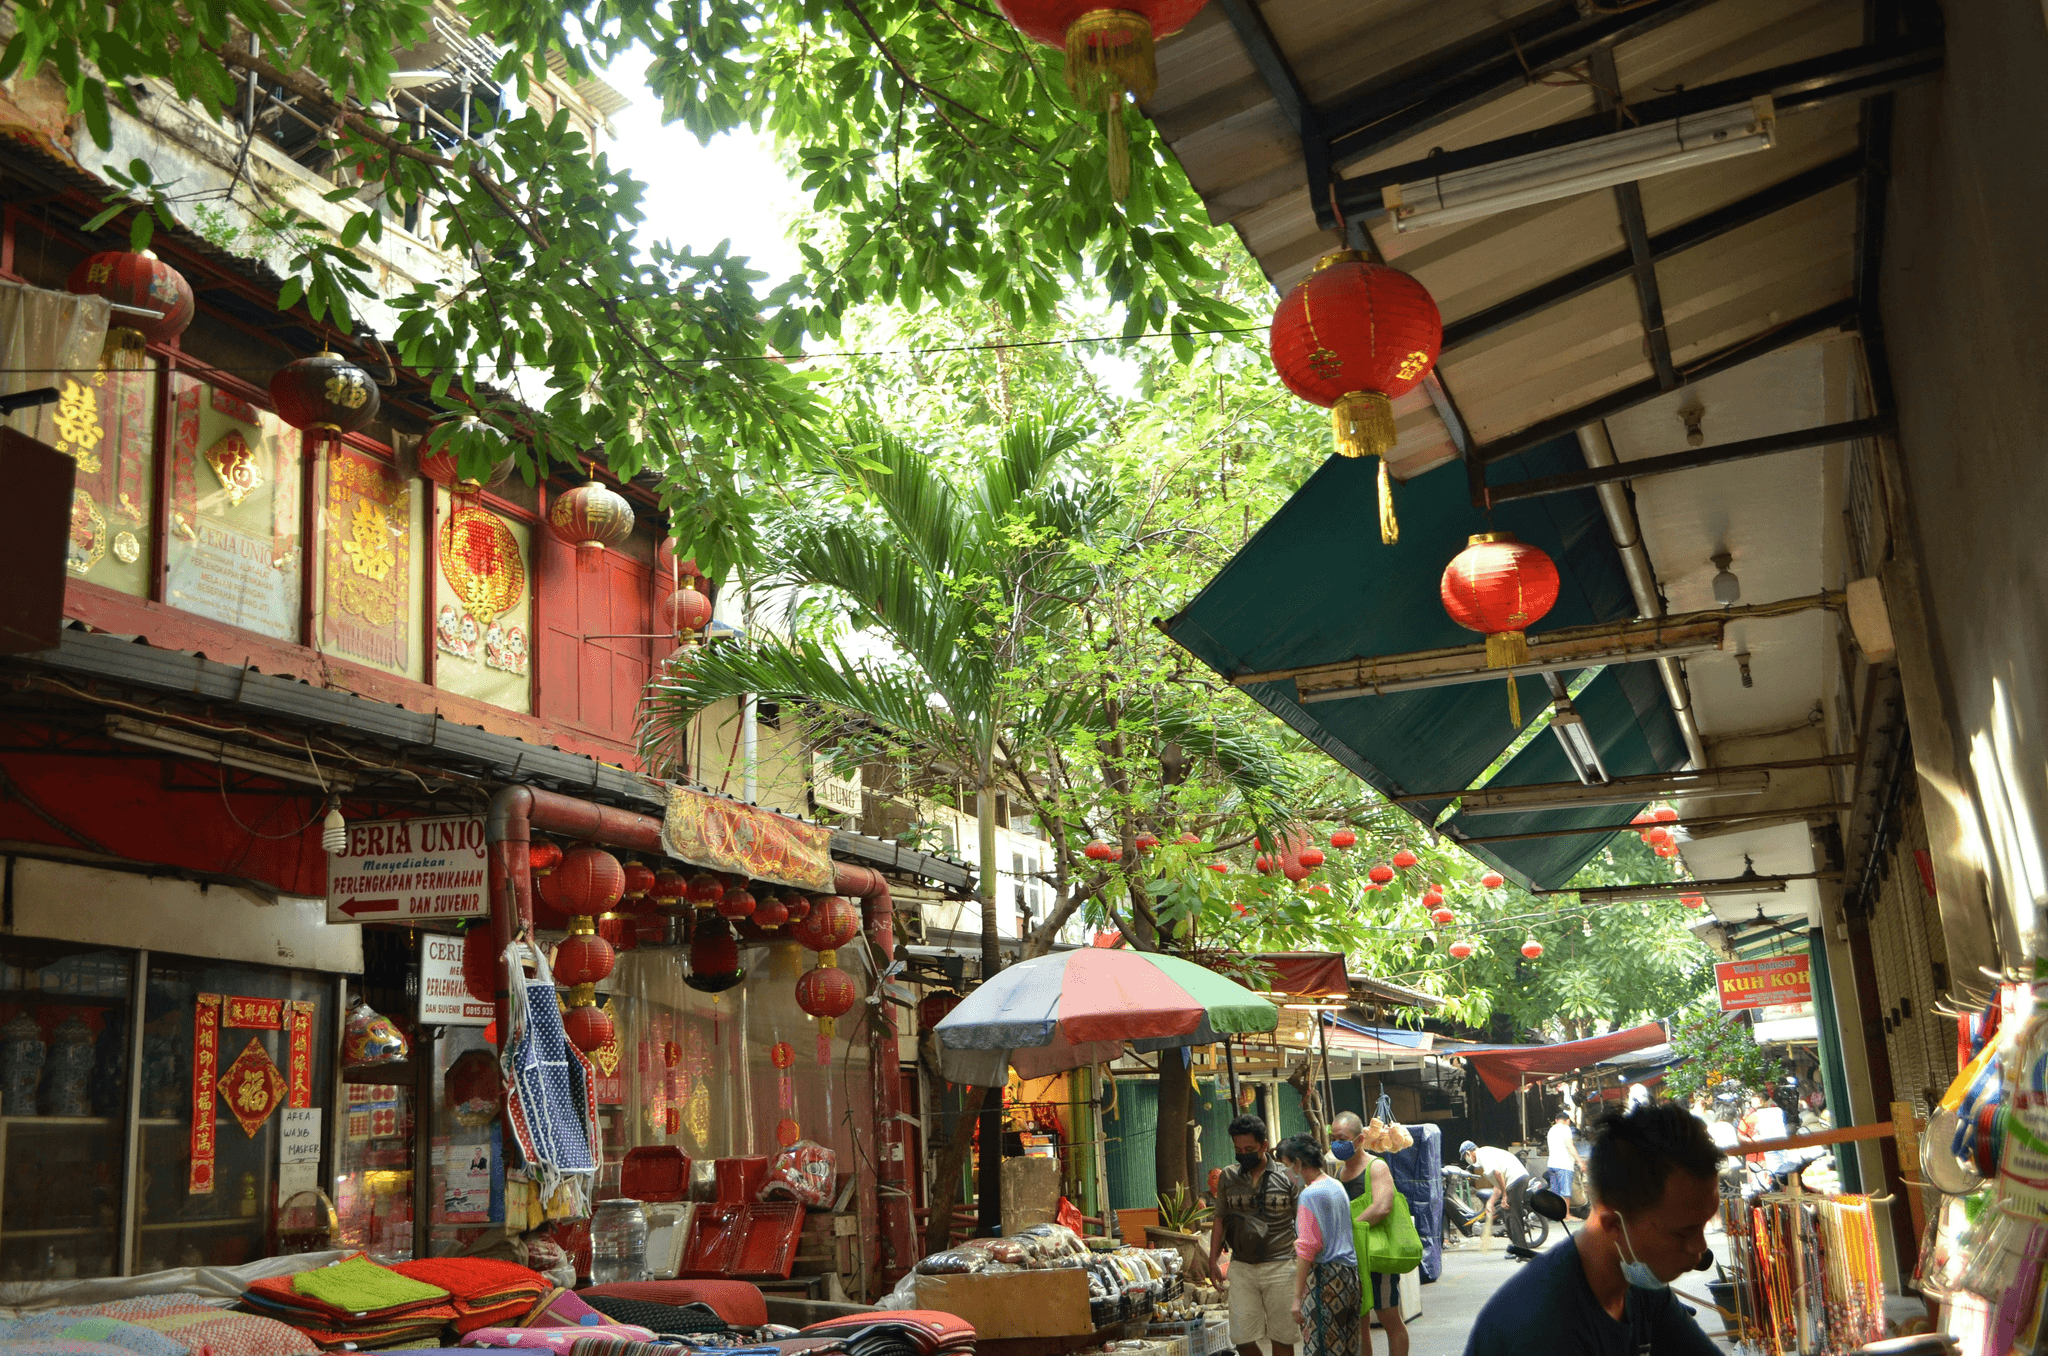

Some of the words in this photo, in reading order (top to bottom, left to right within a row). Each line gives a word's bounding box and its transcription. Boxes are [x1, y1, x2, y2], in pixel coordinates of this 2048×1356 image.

[199, 526, 237, 554] CERIA
[241, 540, 273, 571] UNIQ
[830, 784, 854, 808] FUNG
[421, 820, 485, 858] UNIQ
[363, 857, 445, 873] Menyediakan
[334, 874, 412, 894] PERLENGKAPAN
[416, 870, 483, 890] PERNIKAHAN
[409, 896, 431, 914] DAN
[434, 894, 480, 912] SUVENIR
[429, 941, 464, 961] CERI
[1757, 959, 1796, 971] MANISAN
[426, 978, 475, 998] PERLENGKAP
[1722, 975, 1765, 993] KUH
[1770, 970, 1810, 987] KOH
[425, 1004, 436, 1013] DAN
[438, 1004, 460, 1014] SUVENIR
[238, 1069, 269, 1112] 福
[283, 1128, 310, 1138] WAJIB
